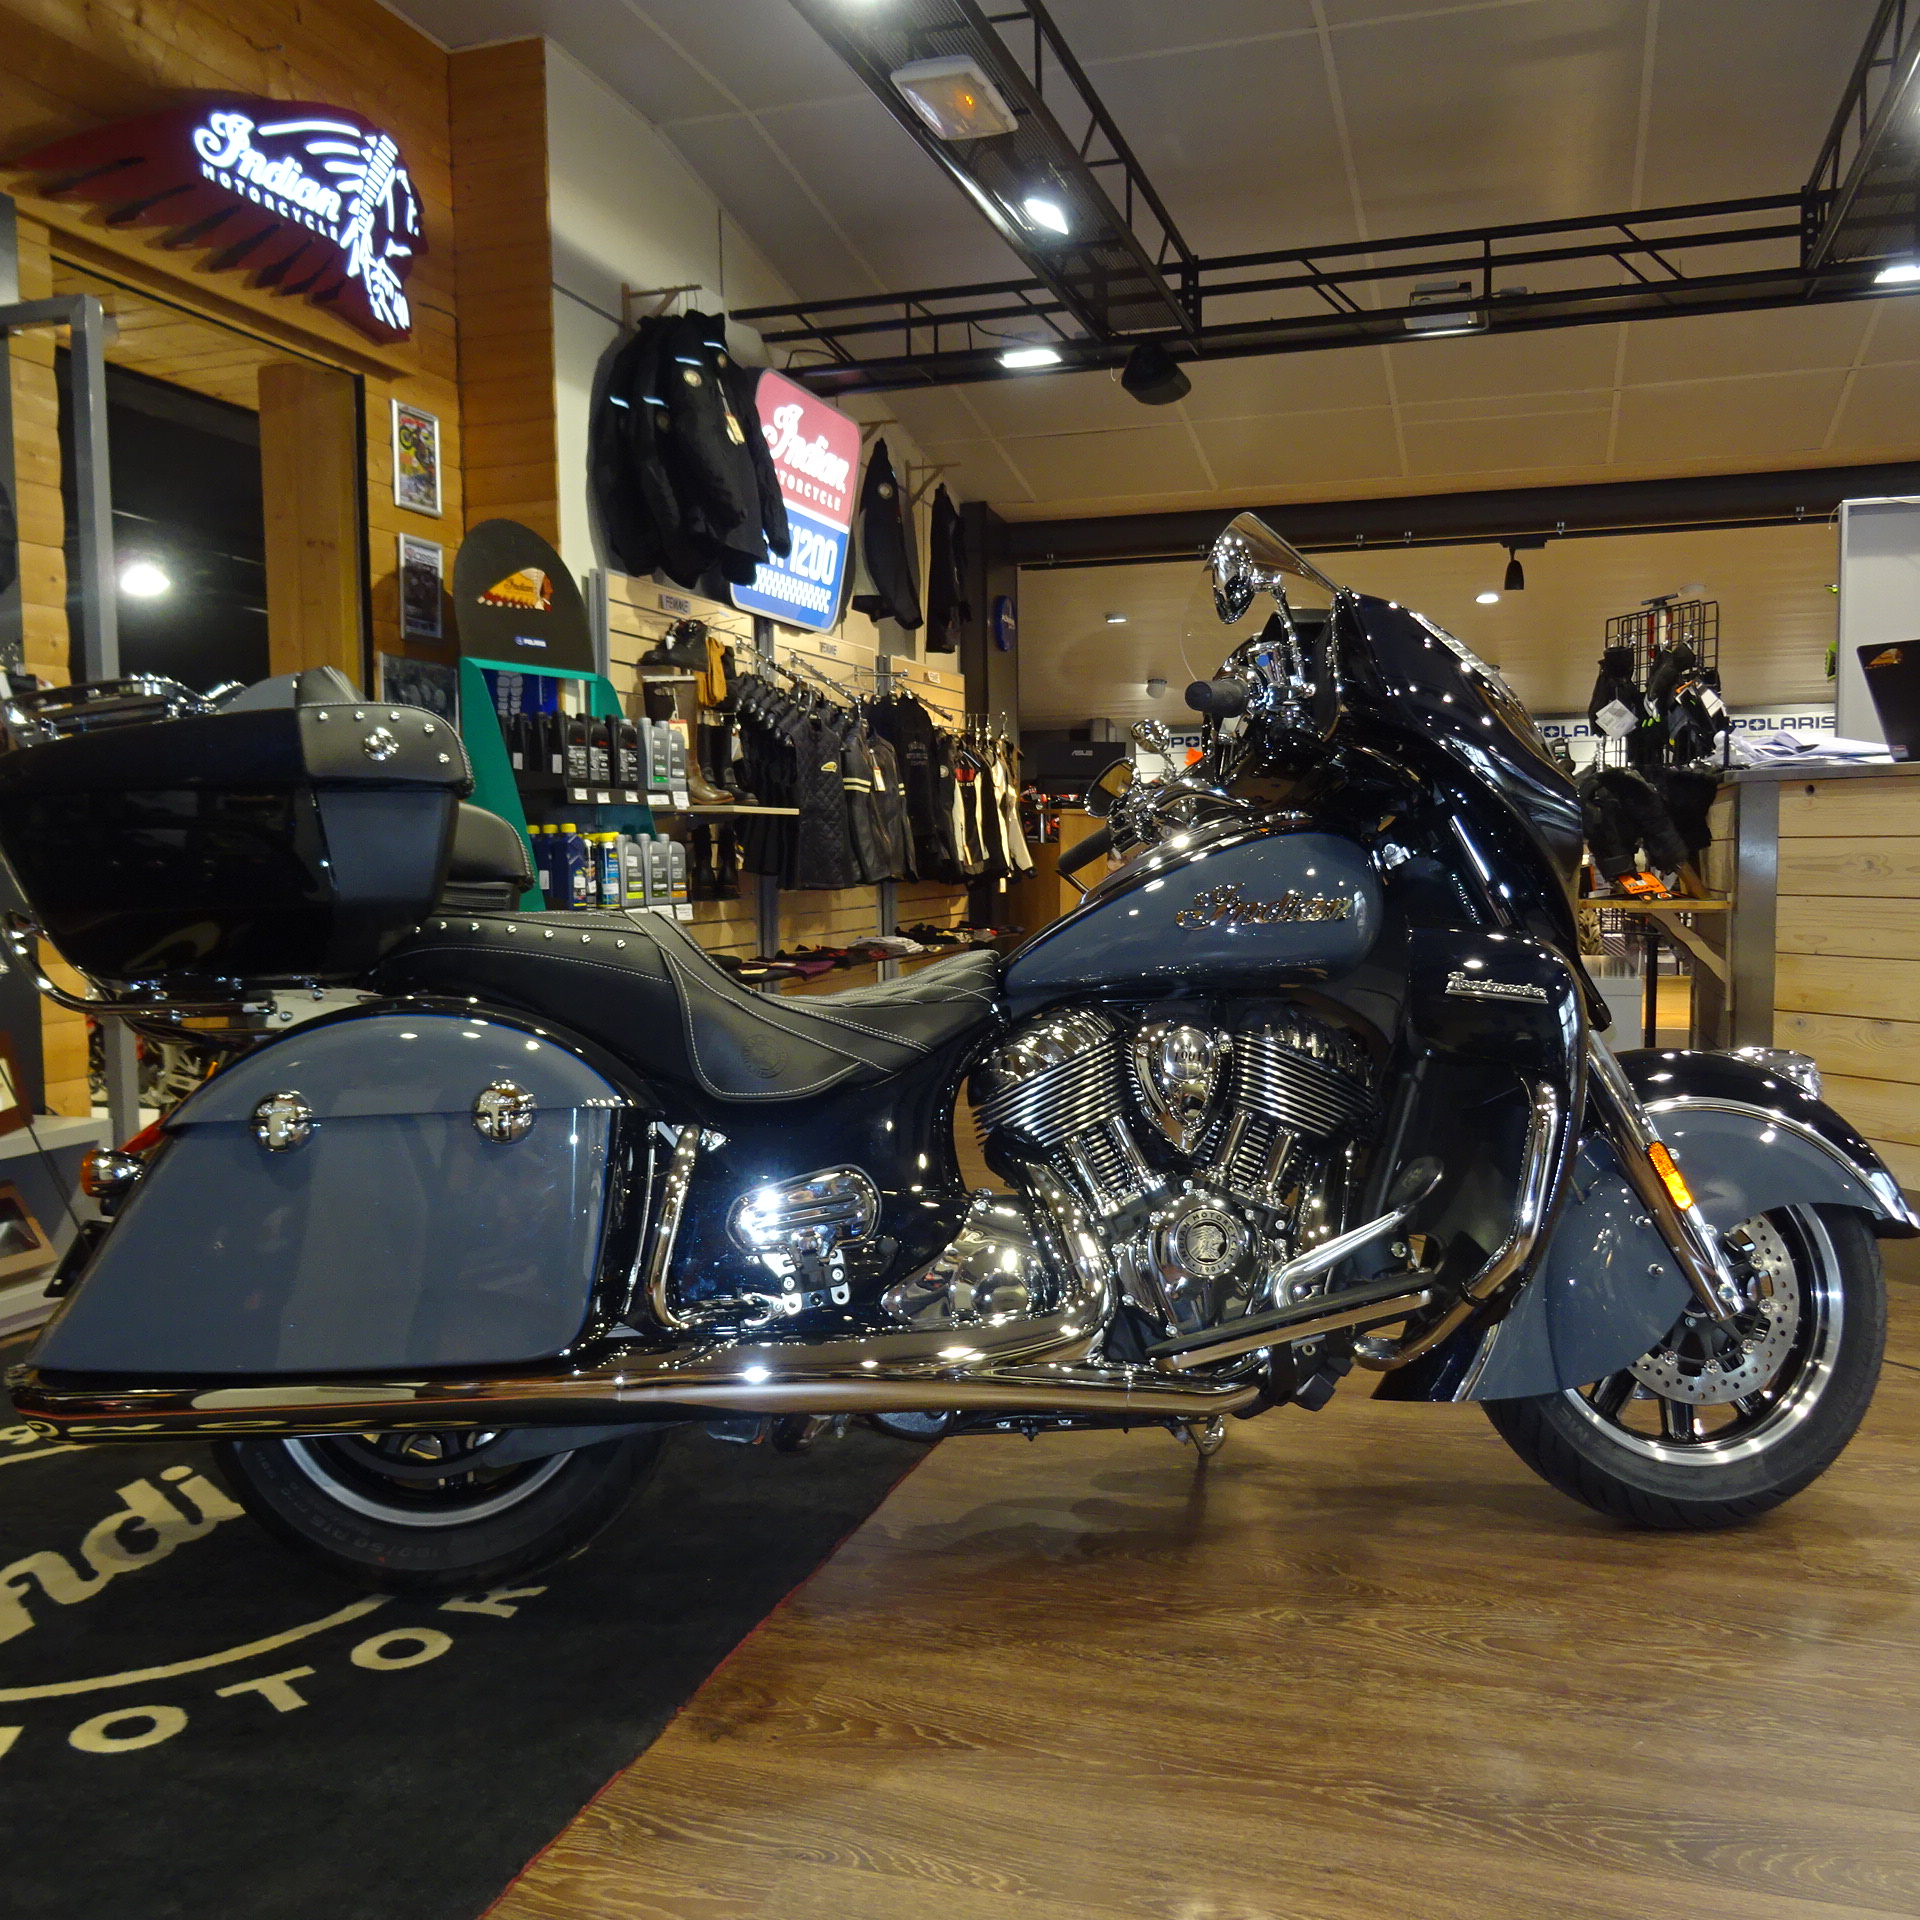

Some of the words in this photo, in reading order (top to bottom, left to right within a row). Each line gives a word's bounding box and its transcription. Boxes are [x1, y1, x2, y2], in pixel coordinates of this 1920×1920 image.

[194, 112, 341, 222] Indian
[202, 163, 339, 242] MOTORCYCLE
[763, 404, 849, 489] Indian
[775, 470, 841, 512] TORCYCLE
[789, 526, 839, 586] 1200
[1732, 716, 1835, 731] POLARIS
[1174, 882, 1352, 931] Indian
[1192, 1212, 1237, 1259] MOTORCYCLE
[0, 1465, 247, 1644] ndi
